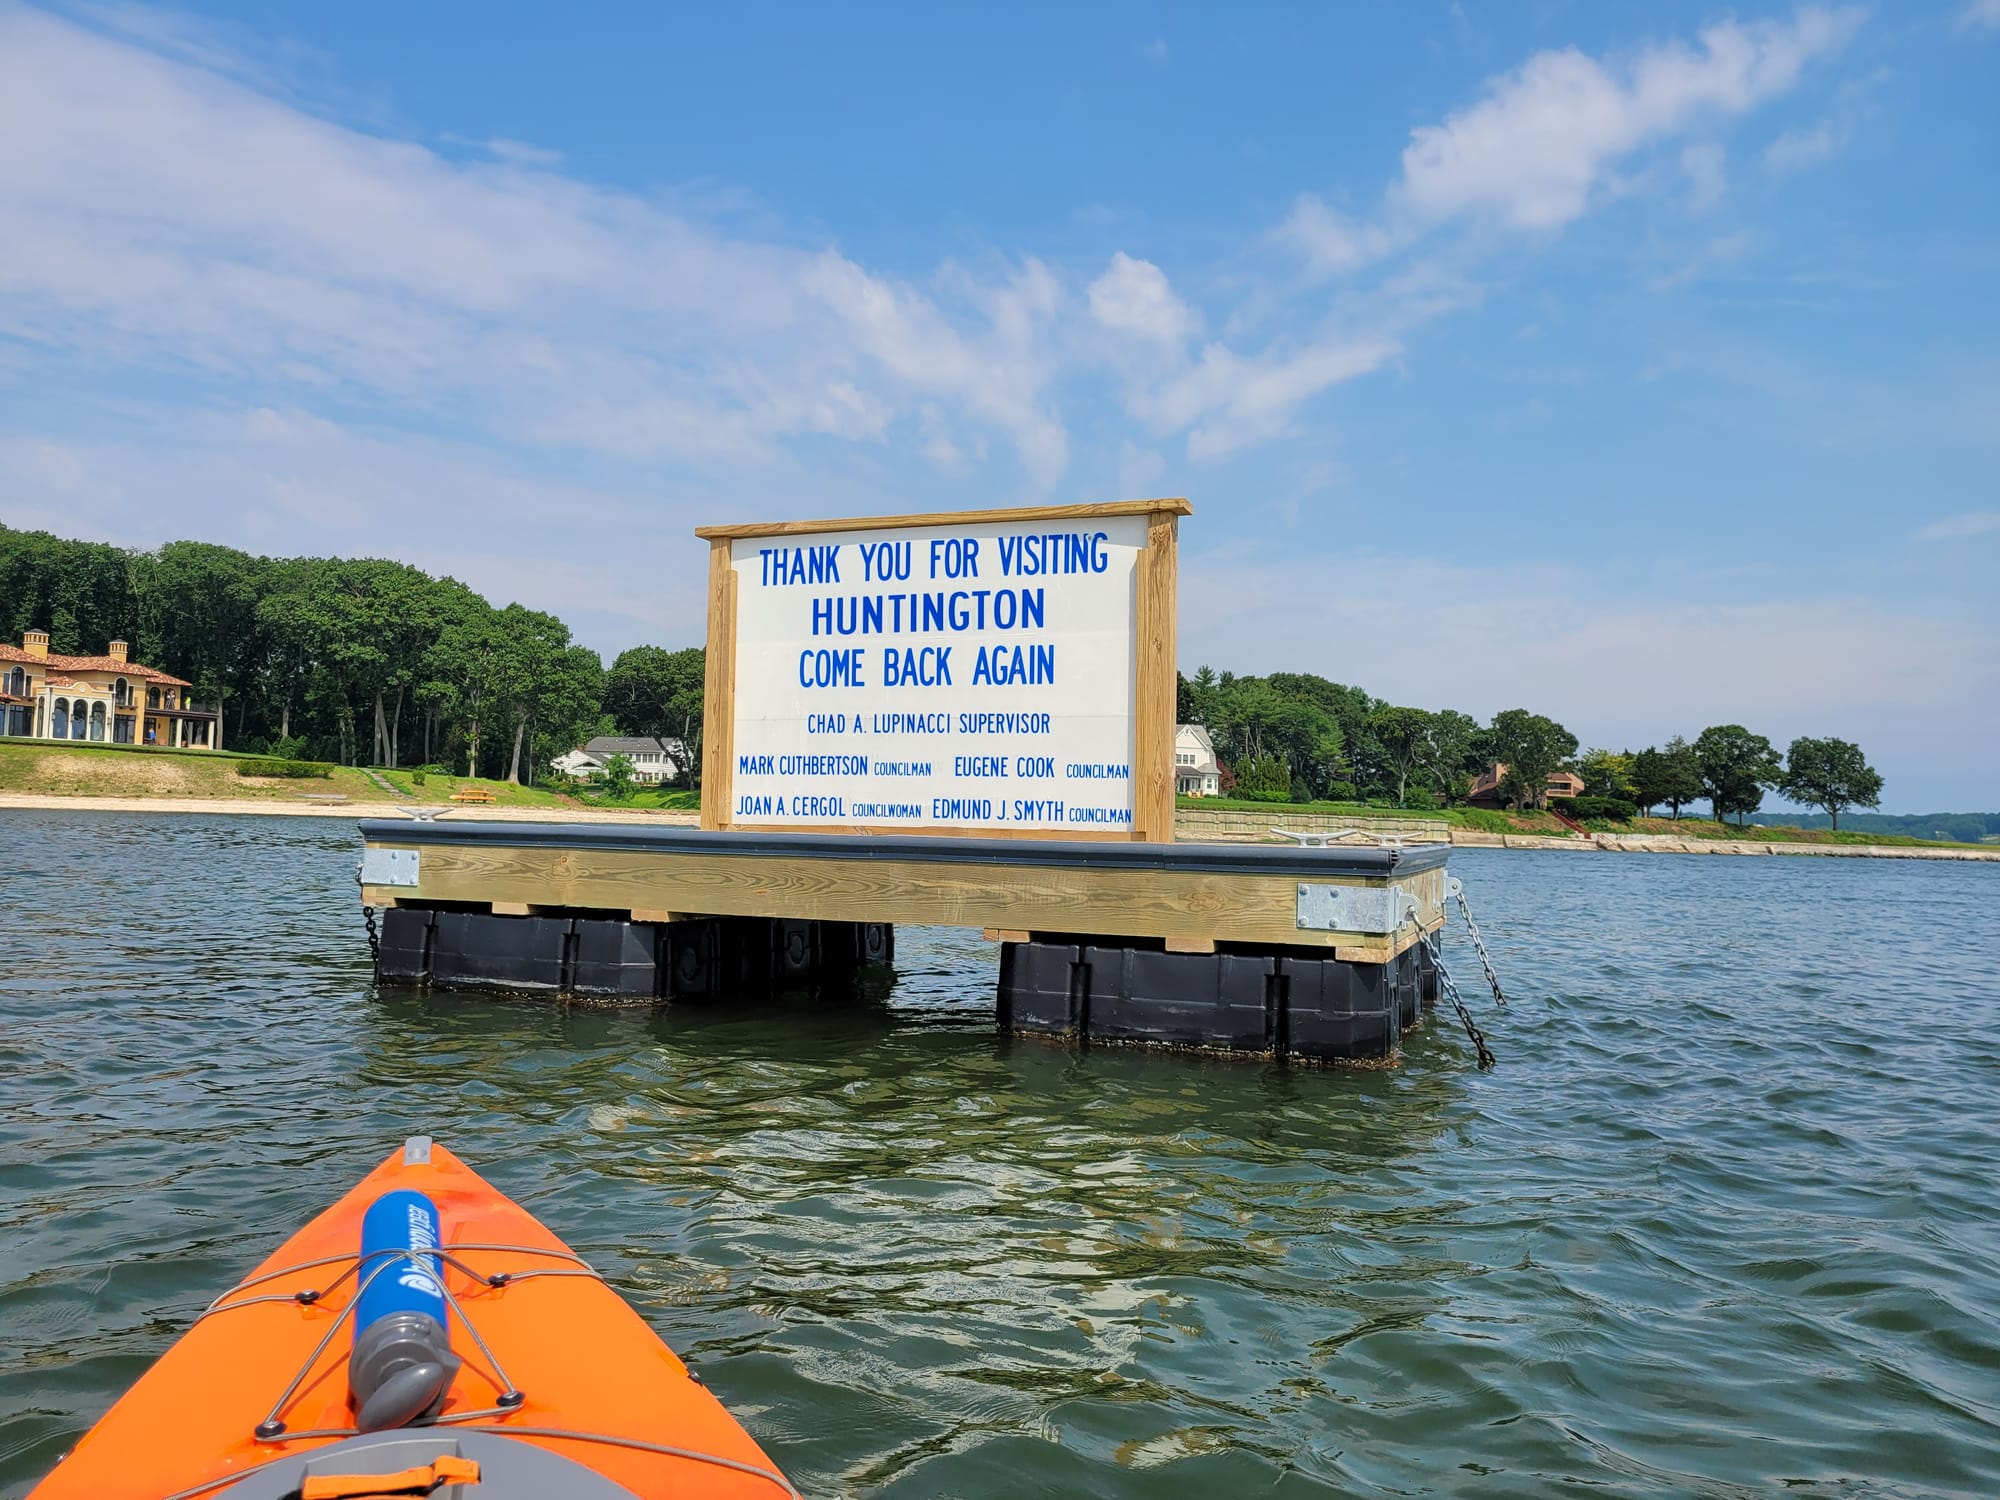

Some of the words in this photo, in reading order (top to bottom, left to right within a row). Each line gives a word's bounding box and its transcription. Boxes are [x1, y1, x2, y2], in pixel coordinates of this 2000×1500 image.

[759, 544, 840, 586] THANK
[859, 541, 911, 582] YOU
[930, 538, 979, 579] FOR
[998, 532, 1108, 576] VISITING
[812, 588, 1044, 636] HUNTINGTON
[799, 649, 865, 688] COME
[884, 646, 952, 687] BACK
[972, 644, 1054, 686] AGAIN
[808, 714, 845, 733] CHAD
[853, 715, 867, 734] A.
[874, 713, 950, 733] LUPINACCI
[960, 713, 1050, 734] SUPERVISOR
[740, 756, 774, 774] MARK
[780, 756, 868, 775] CUTHBERTSON
[875, 763, 931, 776] COUNCILMAN
[955, 756, 1008, 777] EUGENE
[1017, 757, 1054, 778] COOK
[1066, 764, 1129, 778] COUNCILMAN
[737, 796, 771, 815] JOAN
[776, 797, 789, 816] A.
[793, 797, 845, 816] CERGOL
[853, 804, 921, 816] COUNCILWOMAN
[933, 799, 991, 819] EDMUND
[997, 800, 1010, 820] J.
[1014, 800, 1063, 821] SMYTH
[1070, 808, 1131, 822] COUNCILMAN
